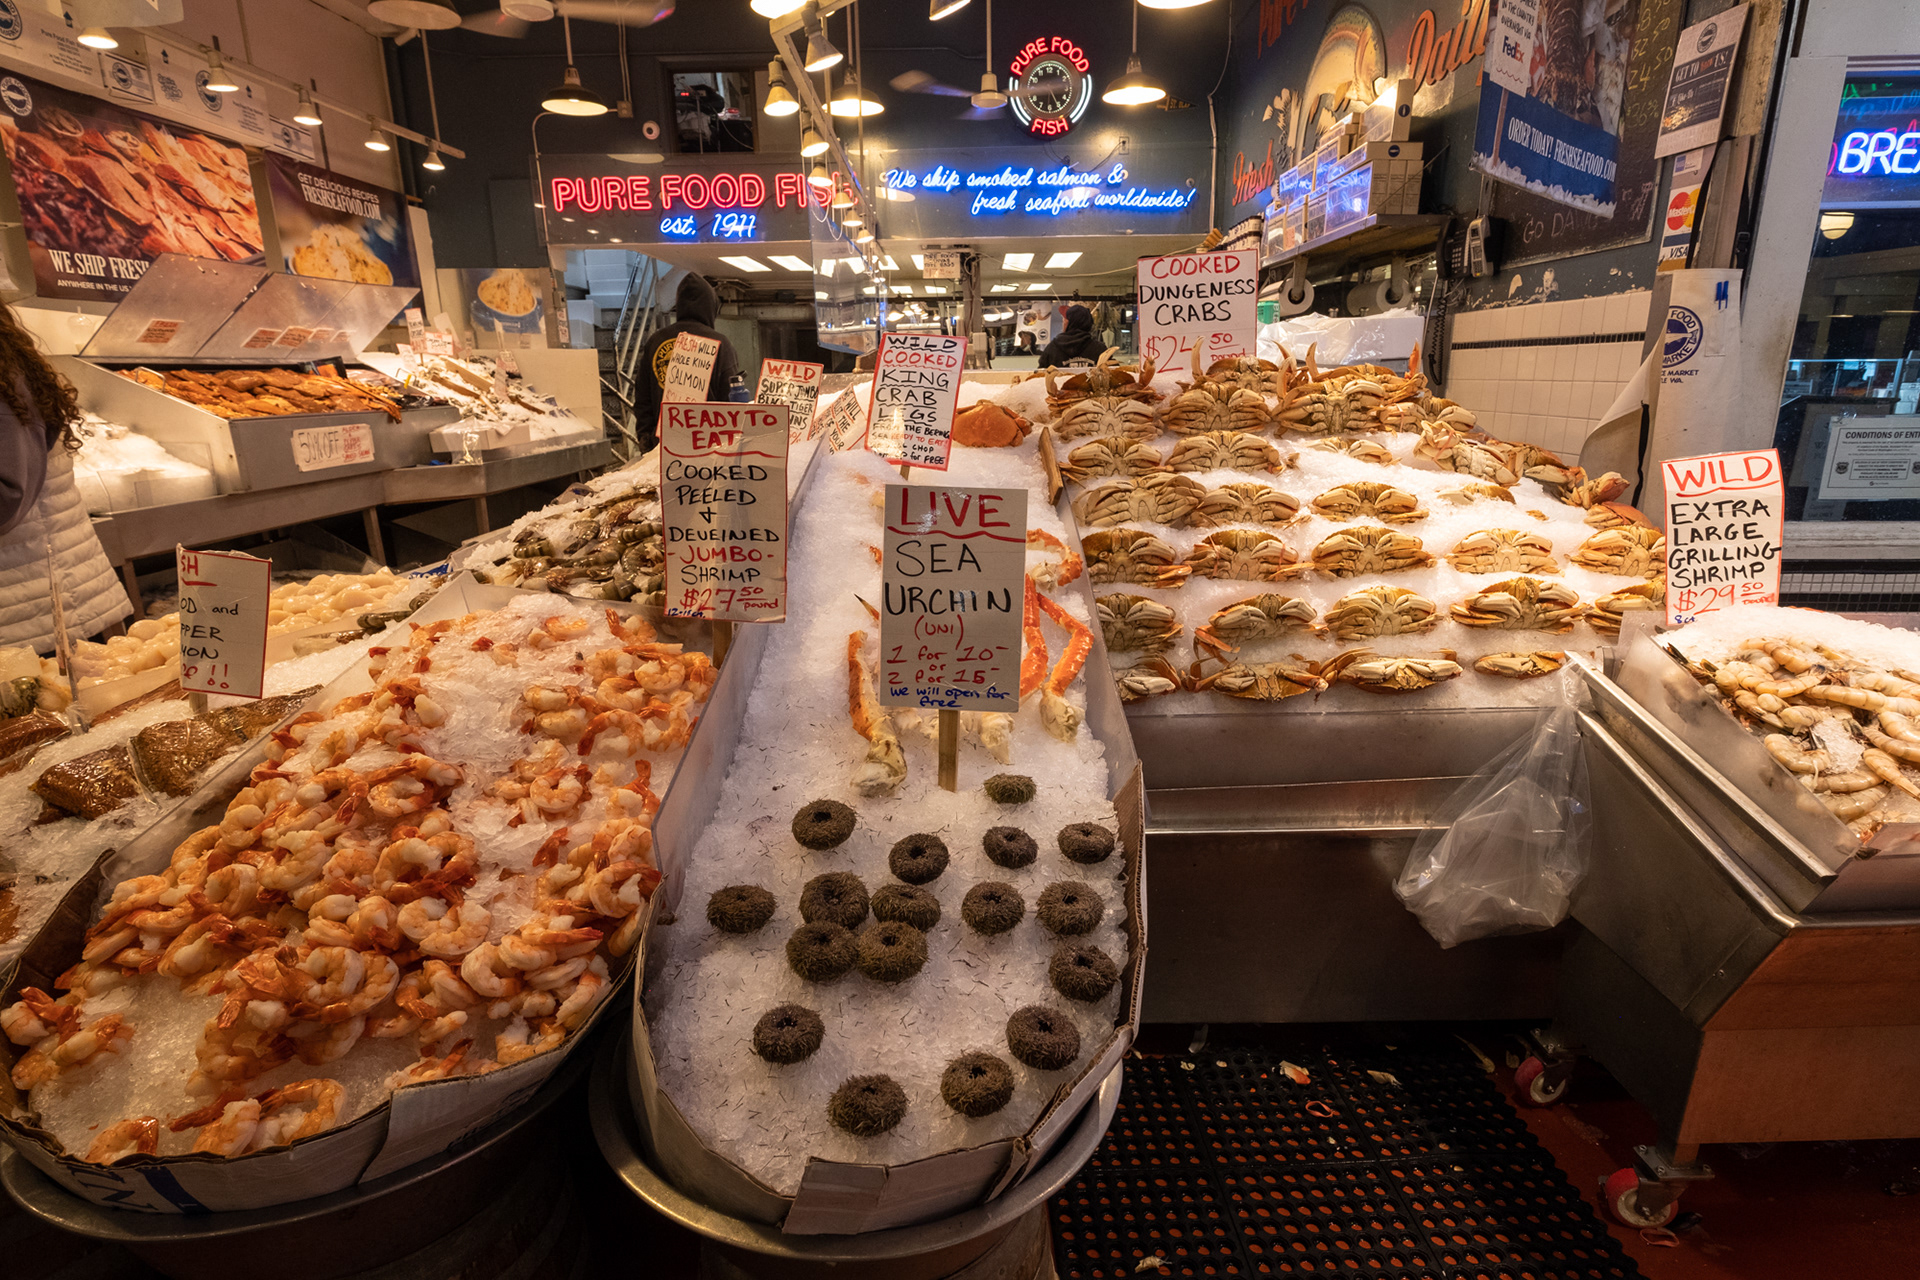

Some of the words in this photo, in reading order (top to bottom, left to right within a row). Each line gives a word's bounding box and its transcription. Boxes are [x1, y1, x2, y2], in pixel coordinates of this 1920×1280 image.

[1010, 36, 1049, 76] PURE
[1051, 36, 1090, 72] FOOD
[1502, 35, 1525, 64] FedEx
[1031, 117, 1069, 135] FISH
[1508, 116, 1531, 148] ORDER
[1530, 127, 1554, 158] TODAY!
[1553, 138, 1618, 182] FRESHSEAFOOD.COM
[1838, 131, 1920, 174] BRE
[298, 172, 313, 185] GET
[313, 177, 351, 195] DELICIOUS
[351, 188, 380, 203] RECIPES
[884, 168, 917, 189] We
[922, 165, 961, 192] ship
[966, 166, 1034, 187] smoked
[1036, 165, 1102, 186] salmon
[1107, 163, 1123, 185] &
[301, 183, 382, 221] FRESHSEAFOOD.COM
[552, 176, 652, 212] PURE
[660, 174, 765, 209] FOOD
[971, 189, 1018, 215] fresh
[1024, 190, 1089, 216] seafood
[1093, 187, 1197, 208] worldwide!
[660, 214, 697, 237] est.
[711, 213, 757, 238] 1911
[48, 249, 75, 274] WE
[74, 251, 108, 277] SHIP
[1670, 246, 1689, 259] VISA
[1151, 255, 1240, 279] COOKED
[57, 279, 95, 290] ANYWHERE
[95, 283, 104, 291] IN
[104, 283, 118, 291] THE
[1139, 278, 1256, 304] DUNGENESS
[1154, 300, 1232, 326] CRABS
[1670, 310, 1696, 329] FOOD
[676, 334, 698, 353] FRESH
[698, 342, 716, 356] WILD
[888, 336, 957, 350] WILD
[1210, 333, 1233, 344] 50
[671, 353, 690, 366] WHOLE
[692, 357, 711, 370] KING
[883, 350, 957, 368] COOKED
[669, 365, 705, 392] SALMON
[767, 361, 816, 381] WILD
[882, 369, 949, 389] KING
[761, 378, 795, 396] SUPR
[875, 387, 937, 406] CRAB
[668, 407, 741, 428] READY
[744, 409, 778, 426] TO
[790, 401, 813, 413] TIGER
[838, 415, 851, 433] THE
[904, 424, 921, 434] THE
[1845, 431, 1893, 439] CONDITIONS
[1894, 431, 1904, 439] OF
[323, 430, 339, 458] OFF
[692, 430, 743, 450] EAT
[830, 428, 845, 450] YOUR
[912, 444, 934, 453] CHOP
[916, 435, 925, 443] TO
[910, 451, 921, 461] for
[924, 455, 945, 465] FREE
[666, 459, 768, 481] COOKED
[1667, 456, 1772, 491] WILD
[675, 485, 756, 505] PEELED
[901, 487, 1011, 528] LIVE
[1671, 499, 1770, 525] EXTRA
[1673, 522, 1763, 546] LARGE
[896, 540, 982, 577] SEA
[1669, 542, 1782, 570] GRILLING
[680, 564, 760, 585] SHRIMP
[1671, 561, 1765, 588] SHRIMP
[212, 603, 239, 616] and
[680, 588, 737, 612] $27
[740, 587, 764, 596] 50
[744, 598, 778, 610] pound
[884, 582, 1012, 615] URCHIN
[1673, 584, 1735, 615] $29
[1741, 582, 1764, 592] 50
[914, 614, 964, 650] (UNI)
[887, 645, 908, 664] 1
[918, 645, 948, 660] for
[888, 672, 903, 684] 2
[917, 687, 940, 696] will
[945, 688, 981, 699] open
[987, 686, 1011, 699] for
[919, 696, 963, 708] free
